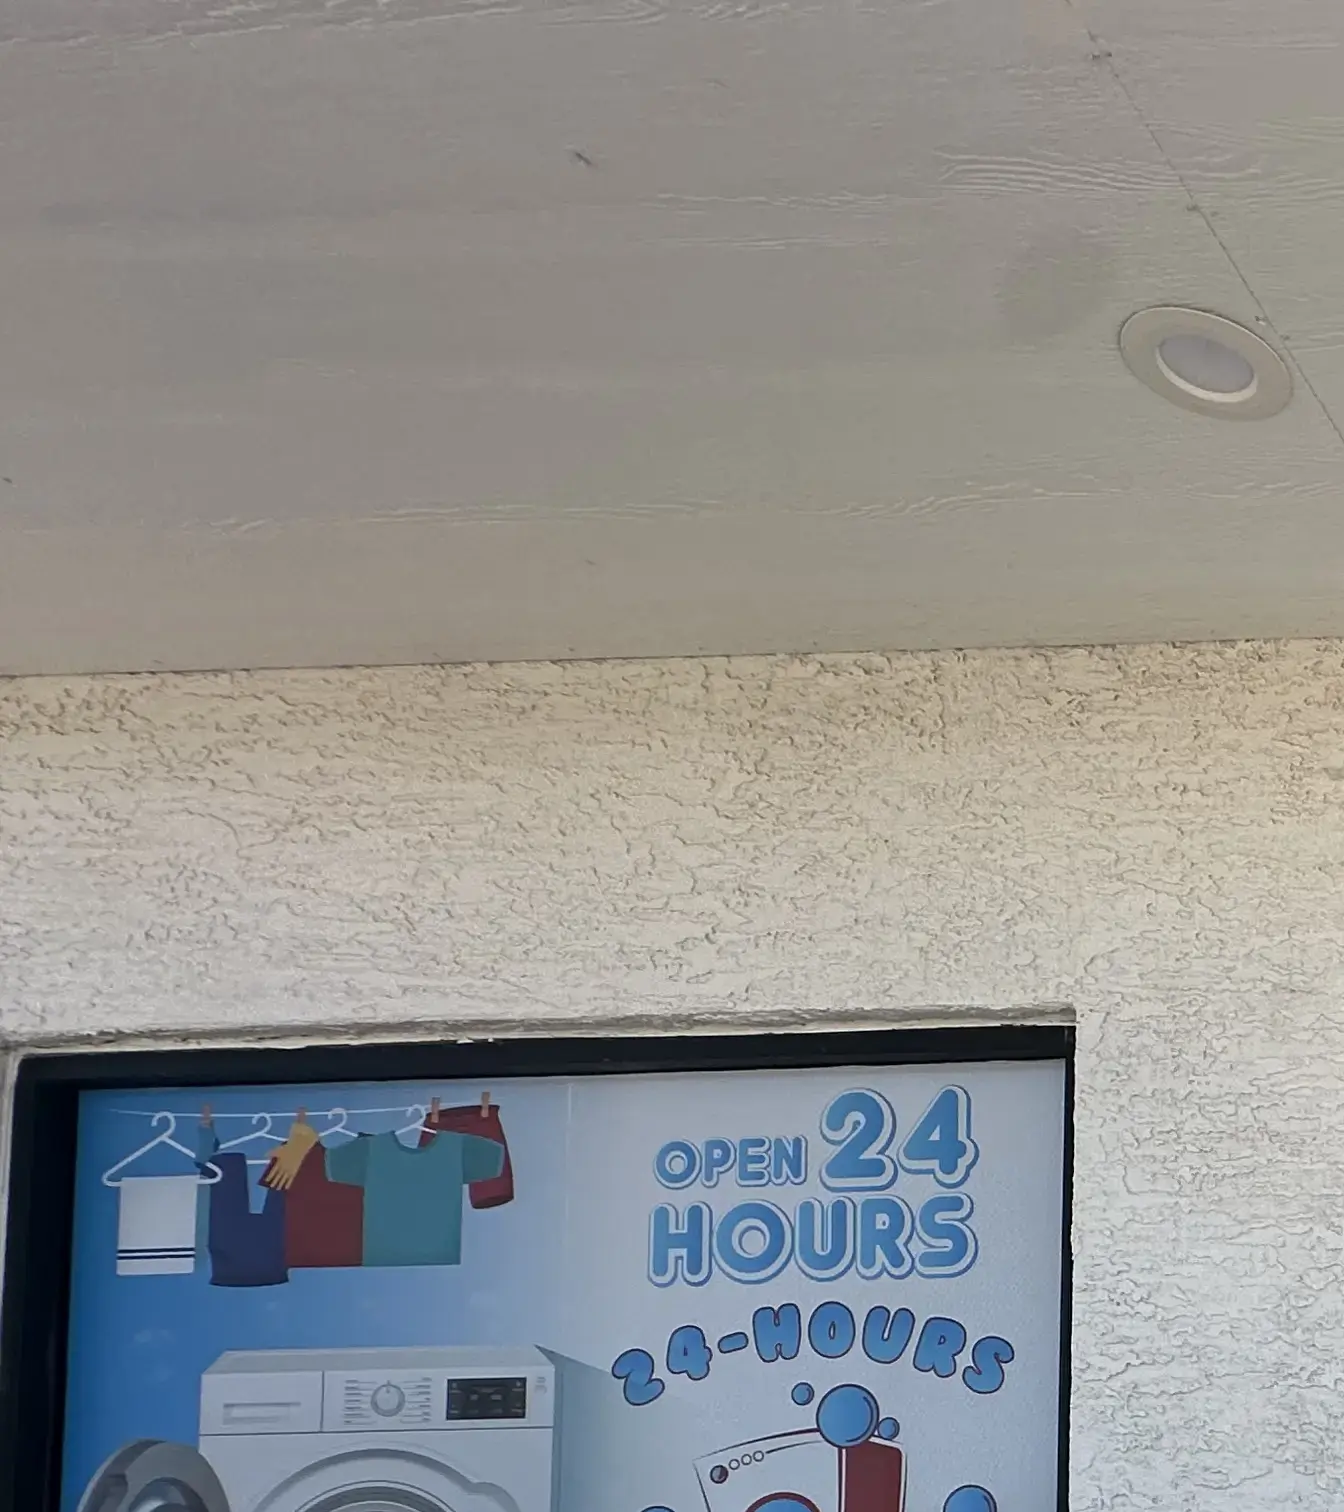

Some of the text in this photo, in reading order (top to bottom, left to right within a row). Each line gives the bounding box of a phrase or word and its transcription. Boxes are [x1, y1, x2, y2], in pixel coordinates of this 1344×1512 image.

[653, 1084, 979, 1191] OPEN 24
[647, 1192, 978, 1288] HOURS
[611, 1301, 1015, 1406] 24-HOURS
